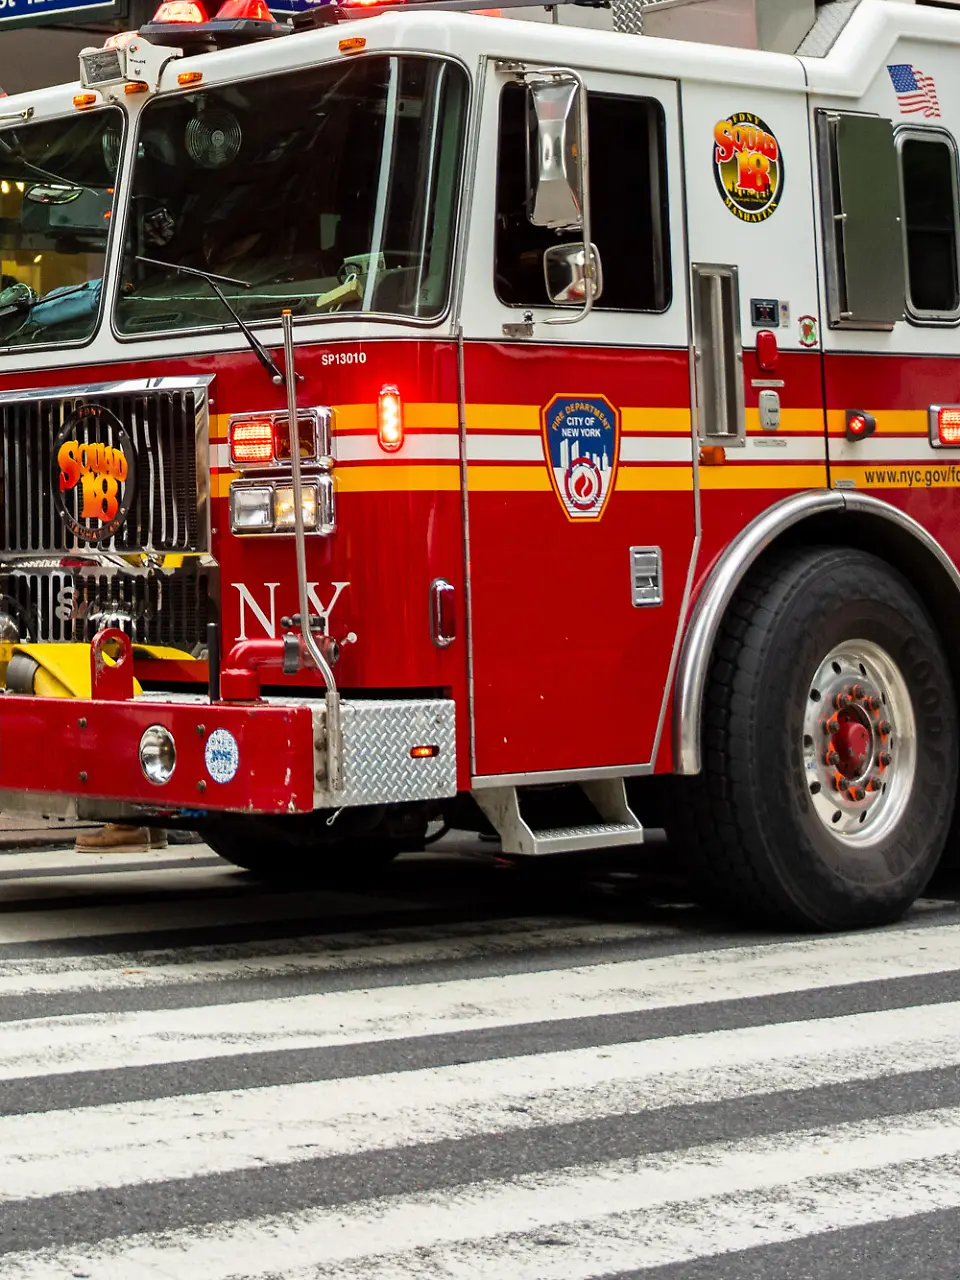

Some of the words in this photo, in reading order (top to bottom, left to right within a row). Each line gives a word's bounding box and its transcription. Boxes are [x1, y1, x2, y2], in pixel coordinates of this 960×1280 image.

[732, 113, 760, 125] FDNY
[713, 119, 779, 165] SQUAD
[735, 149, 772, 193] 18
[321, 352, 367, 366] SP13010
[551, 410, 565, 431] FIRE
[565, 402, 611, 430] DEPARTMENT
[566, 416, 583, 426] CITY
[584, 417, 596, 426] OF
[561, 428, 579, 437] NEW
[580, 428, 601, 437] YORK
[57, 439, 129, 493] SQUAD
[81, 471, 119, 522] 18
